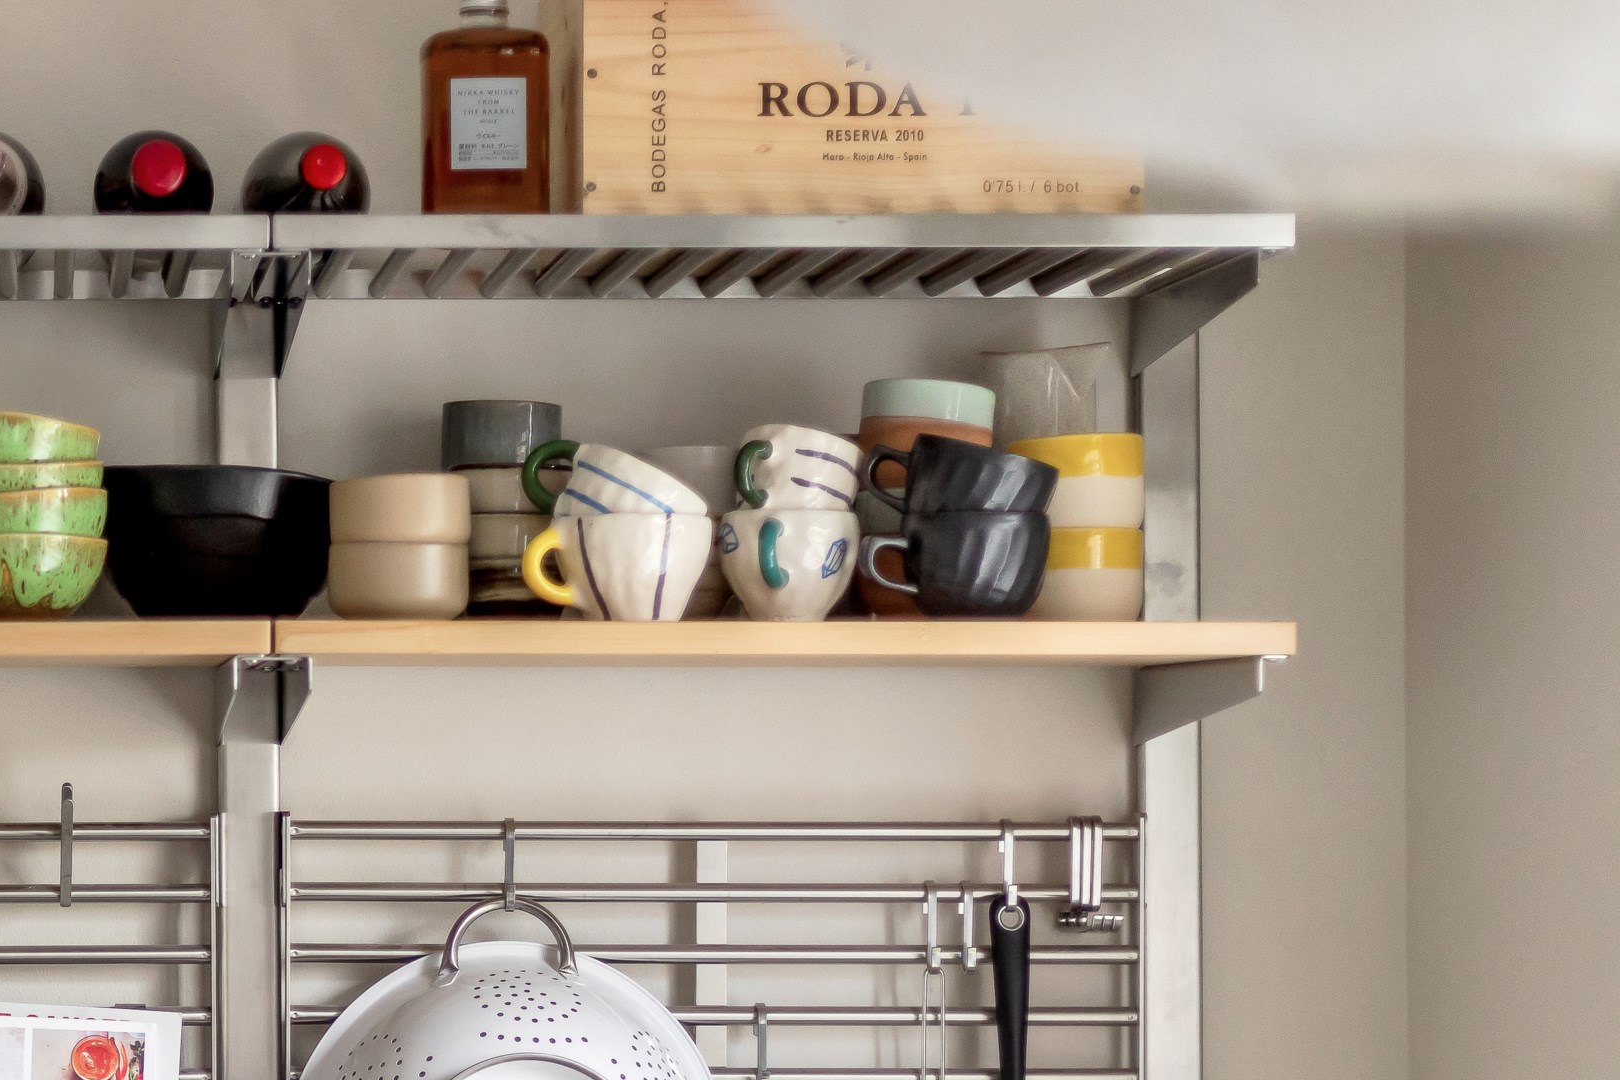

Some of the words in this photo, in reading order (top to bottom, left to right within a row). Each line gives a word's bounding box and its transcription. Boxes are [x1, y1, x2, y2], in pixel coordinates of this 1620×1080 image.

[757, 81, 928, 117] RODA
[651, 89, 666, 193] BODEGAS
[826, 129, 888, 142] RESERVA
[895, 129, 924, 142] 2010
[822, 152, 845, 161] Haro
[853, 152, 874, 163] Rioja
[876, 152, 895, 161] Alta
[903, 152, 928, 163] Spain
[1043, 180, 1052, 193] 6
[1056, 180, 1083, 193] bot.
